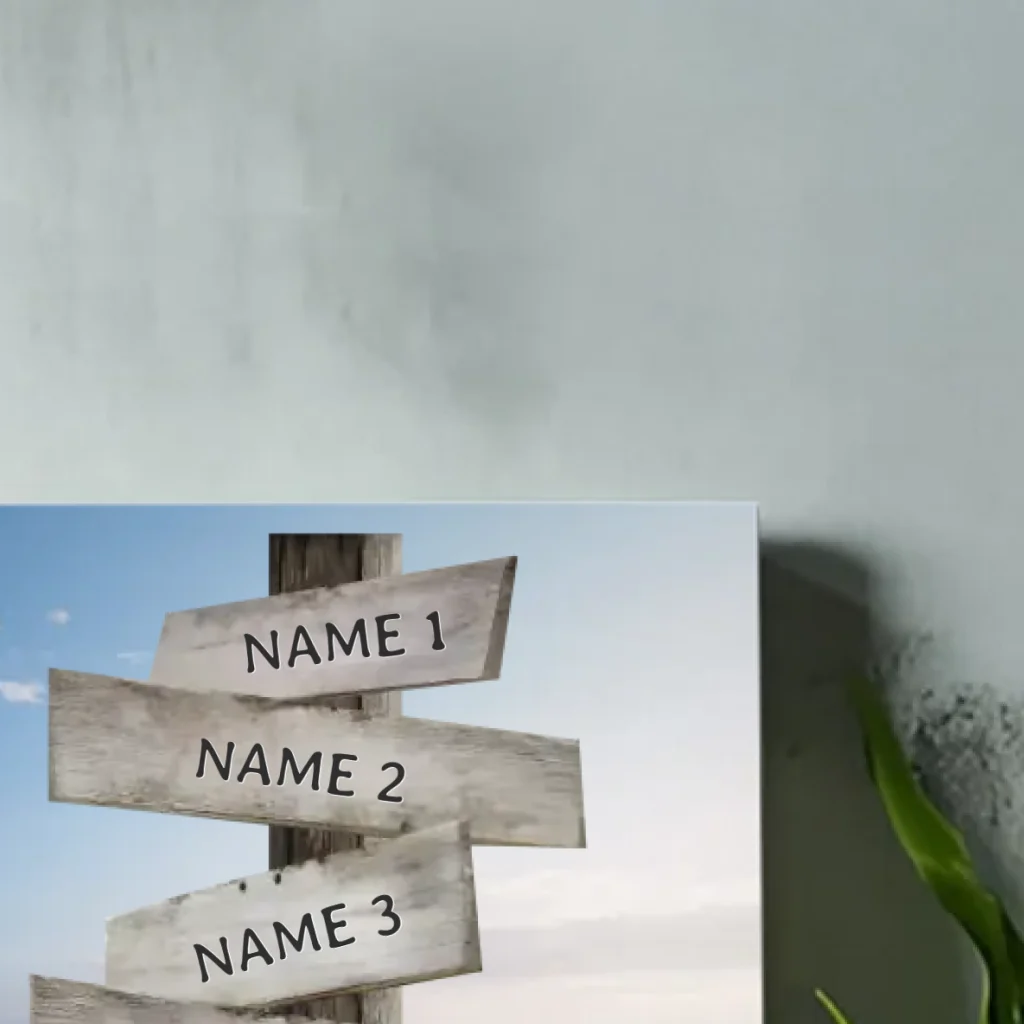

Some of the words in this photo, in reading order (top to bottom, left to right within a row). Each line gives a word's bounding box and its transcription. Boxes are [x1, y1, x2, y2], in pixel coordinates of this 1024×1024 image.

[244, 613, 405, 673] NAME
[426, 611, 445, 651] 1
[196, 738, 358, 797] NAME
[377, 762, 405, 803] 2
[193, 903, 356, 983] NAME
[371, 894, 401, 936] 3
